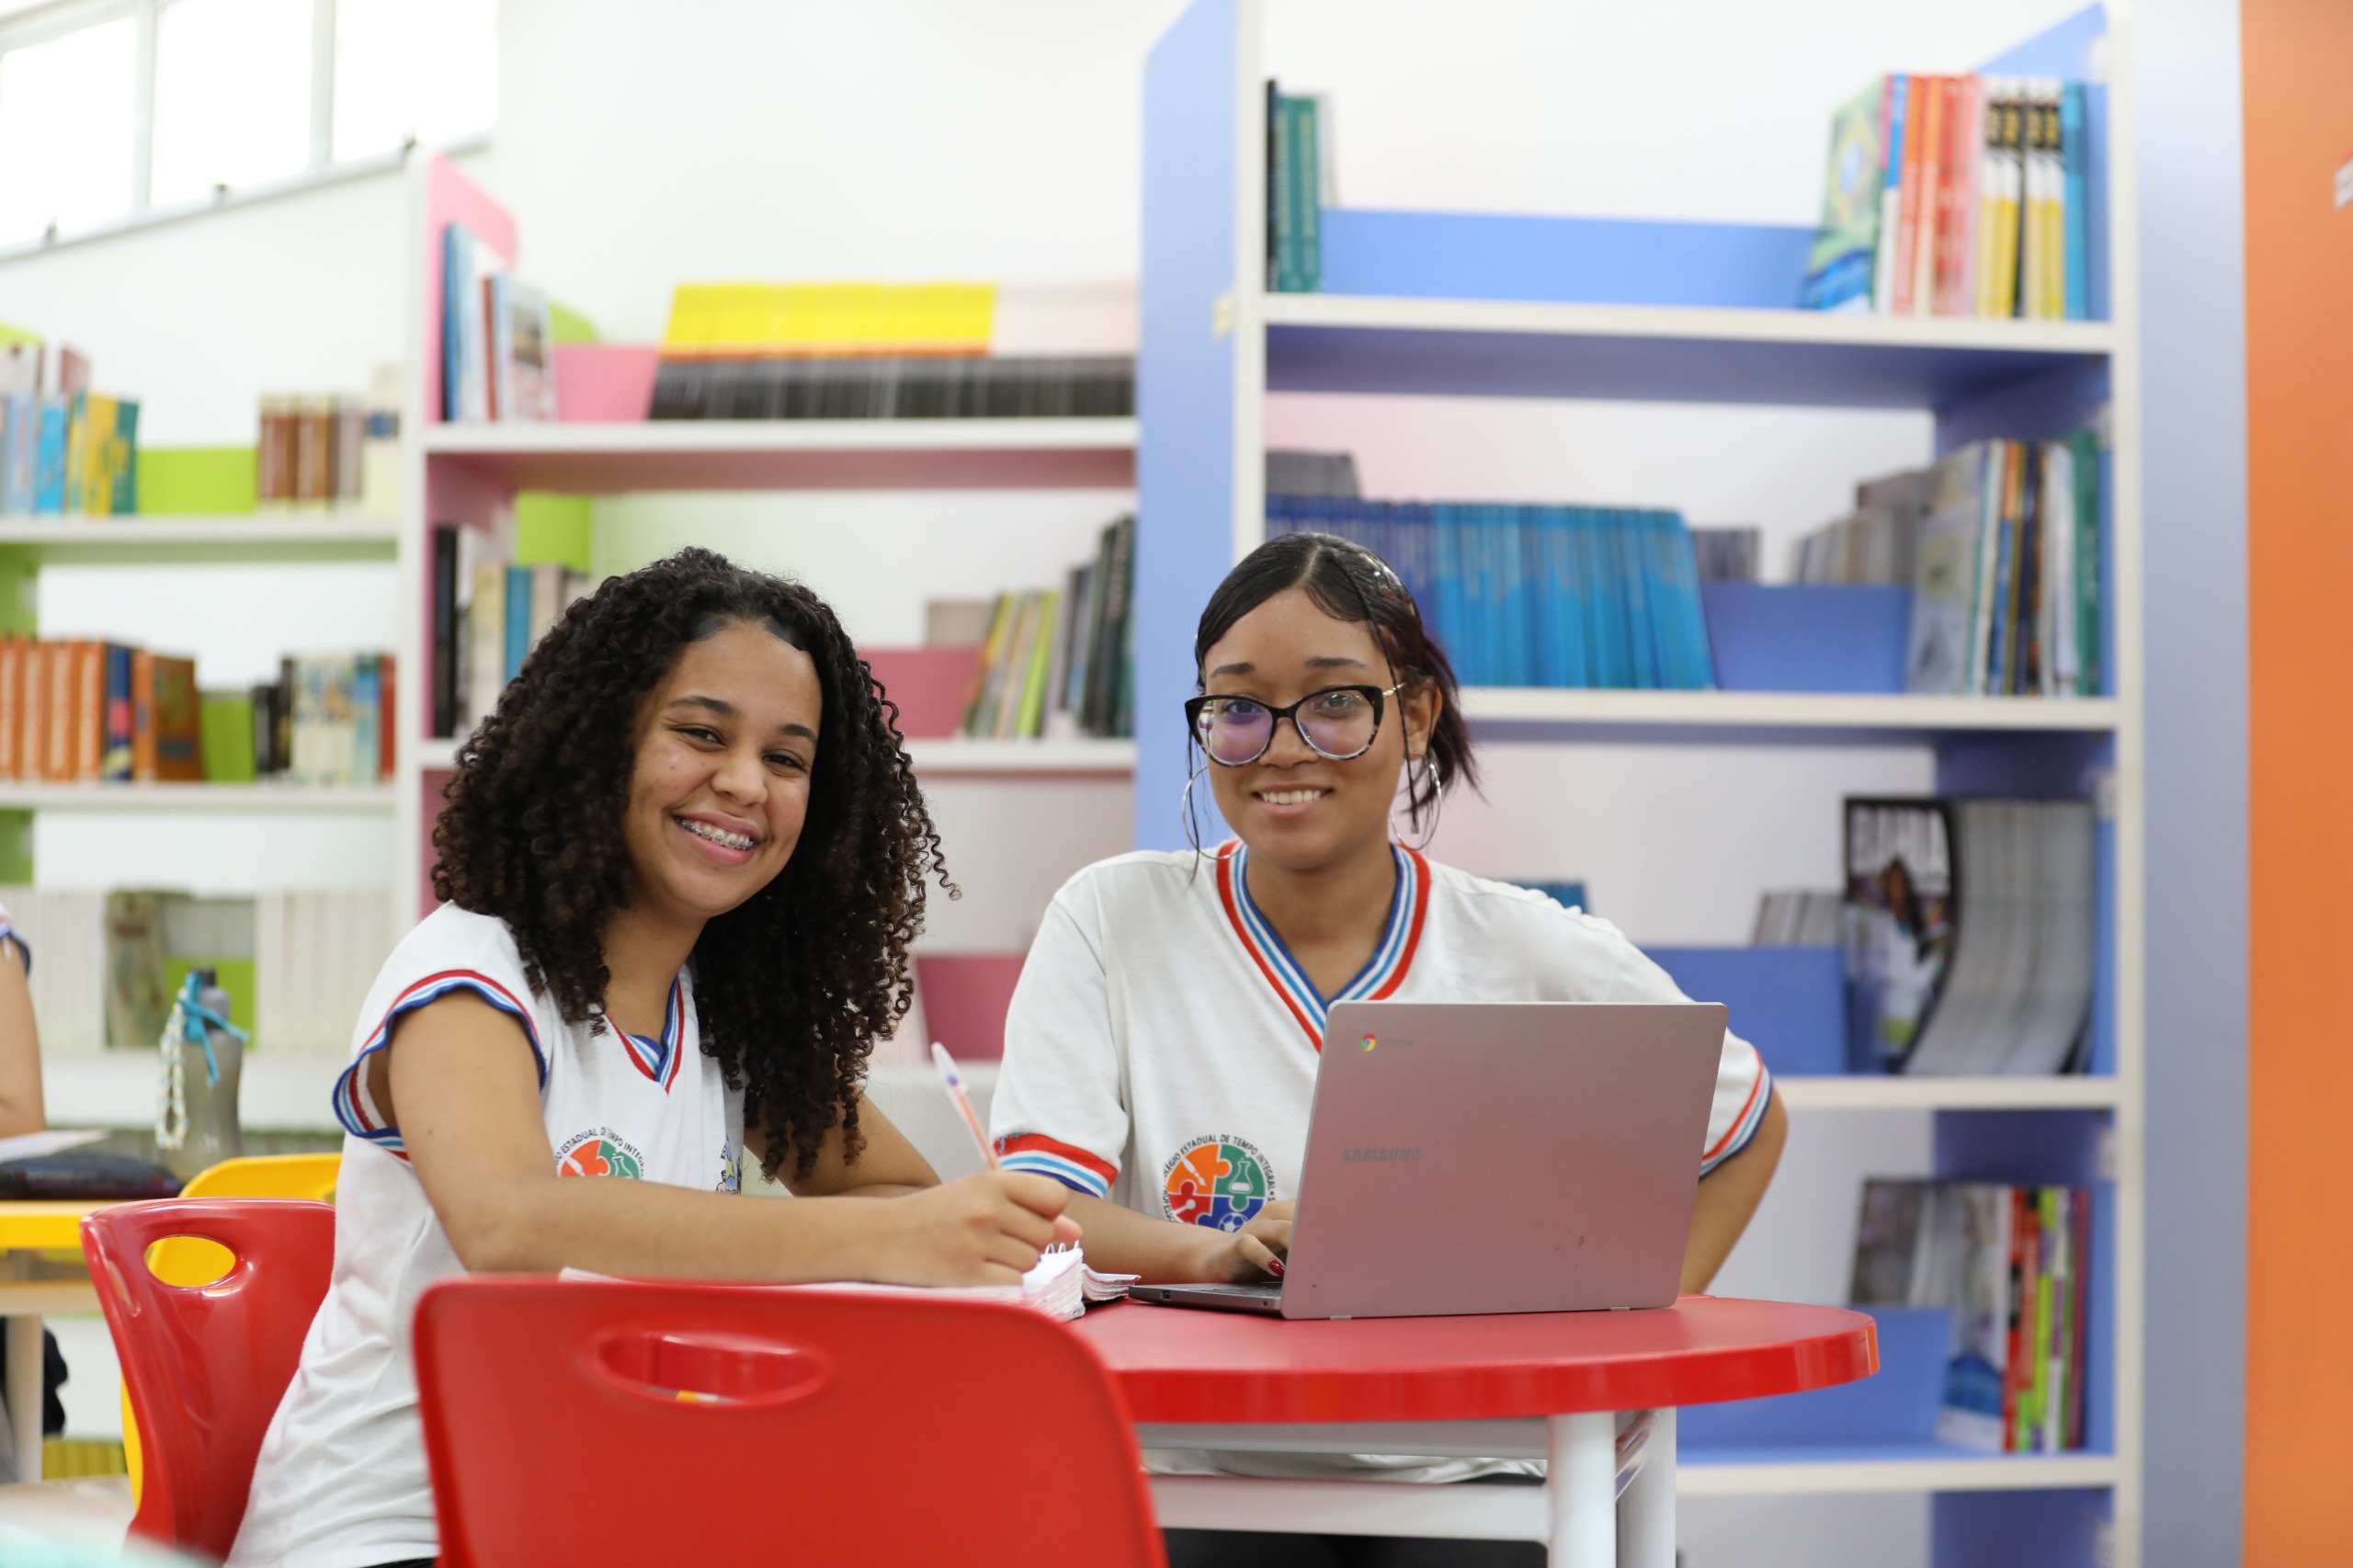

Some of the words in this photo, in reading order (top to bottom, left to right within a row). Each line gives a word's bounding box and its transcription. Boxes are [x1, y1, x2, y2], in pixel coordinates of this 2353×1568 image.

[560, 1128, 598, 1153] ESTADUAL
[599, 1126, 607, 1136] DE
[607, 1128, 623, 1147] TEMPO
[1180, 1134, 1217, 1155] ESTADUAL
[1220, 1133, 1231, 1143] DE
[1233, 1136, 1259, 1155] TEMPO
[1256, 1153, 1277, 1191] INTEGRAL
[1341, 1147, 1422, 1163] SAMSUNG
